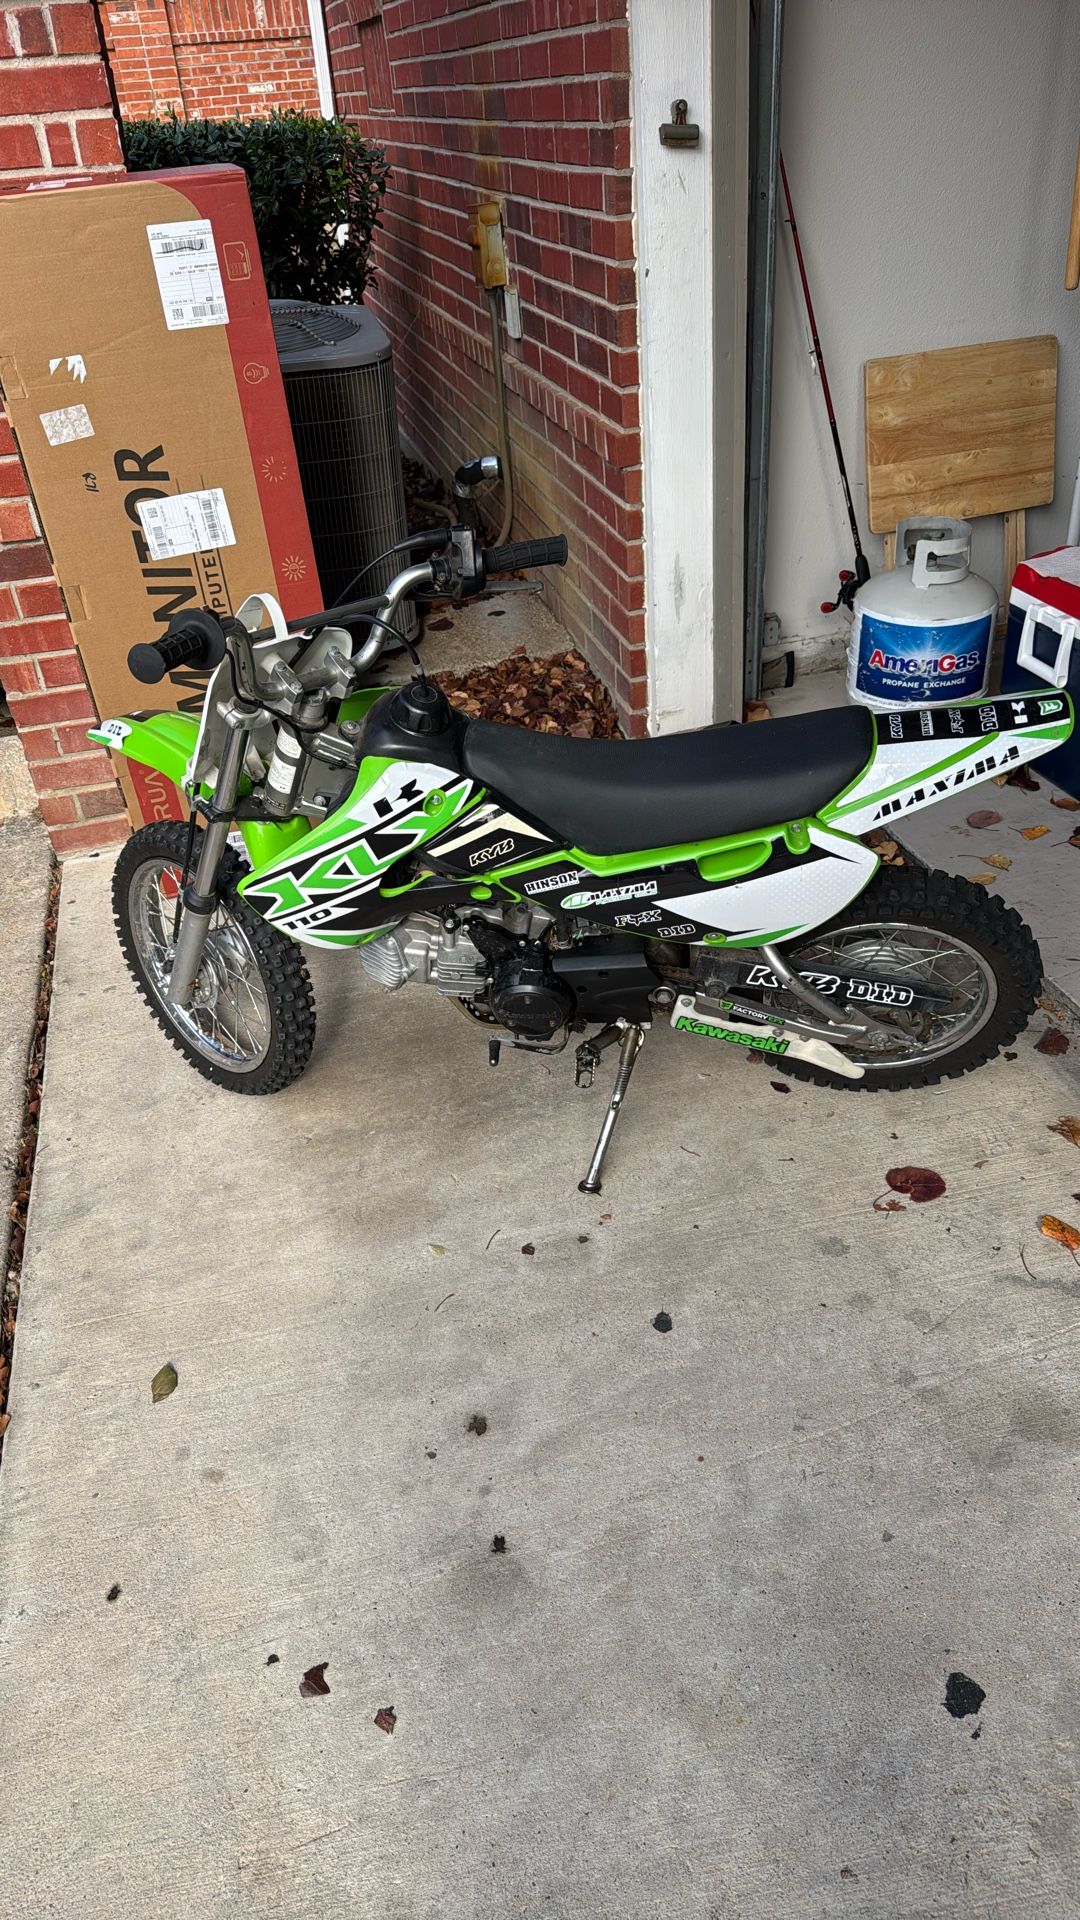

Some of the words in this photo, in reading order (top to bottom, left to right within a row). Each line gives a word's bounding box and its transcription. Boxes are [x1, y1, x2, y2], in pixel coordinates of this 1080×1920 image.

[114, 445, 213, 712] MNITOR
[868, 648, 979, 675] AmeriGas
[882, 678, 919, 688] PROPANE
[923, 677, 966, 688] EXCHANGE
[144, 770, 172, 820] RUA
[873, 745, 1020, 822] MAXIMA
[243, 779, 474, 920] KLX
[469, 838, 515, 867] KYB
[525, 871, 578, 893] HINSON
[282, 907, 332, 931] 110
[746, 965, 840, 995] KB
[733, 1006, 768, 1020] FACTORY
[675, 1016, 791, 1054] Kawasaki
